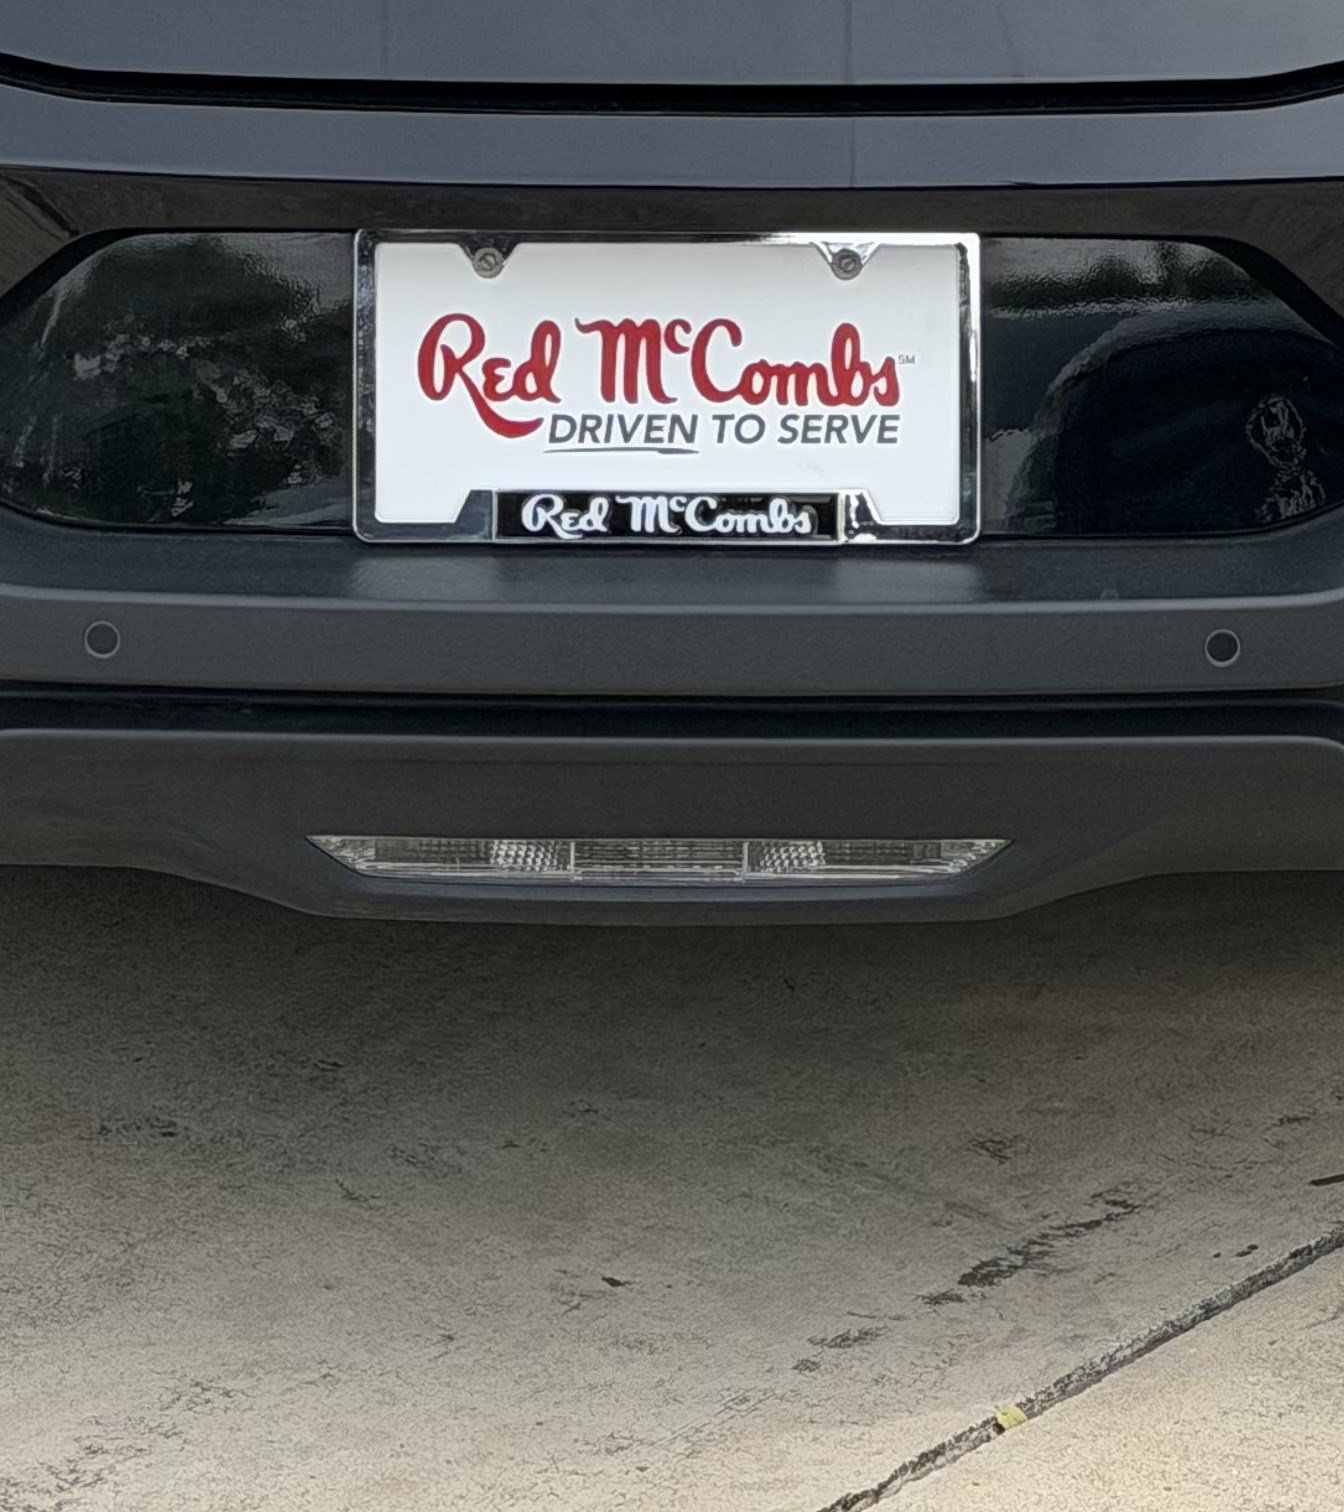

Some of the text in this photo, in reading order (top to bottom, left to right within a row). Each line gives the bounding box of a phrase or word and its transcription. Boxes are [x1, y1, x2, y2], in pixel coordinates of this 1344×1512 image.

[417, 313, 562, 439] Red
[575, 318, 901, 407] McCombs
[548, 414, 900, 444] DRIVEN TO SERVE
[521, 493, 814, 539] Red McCombs
